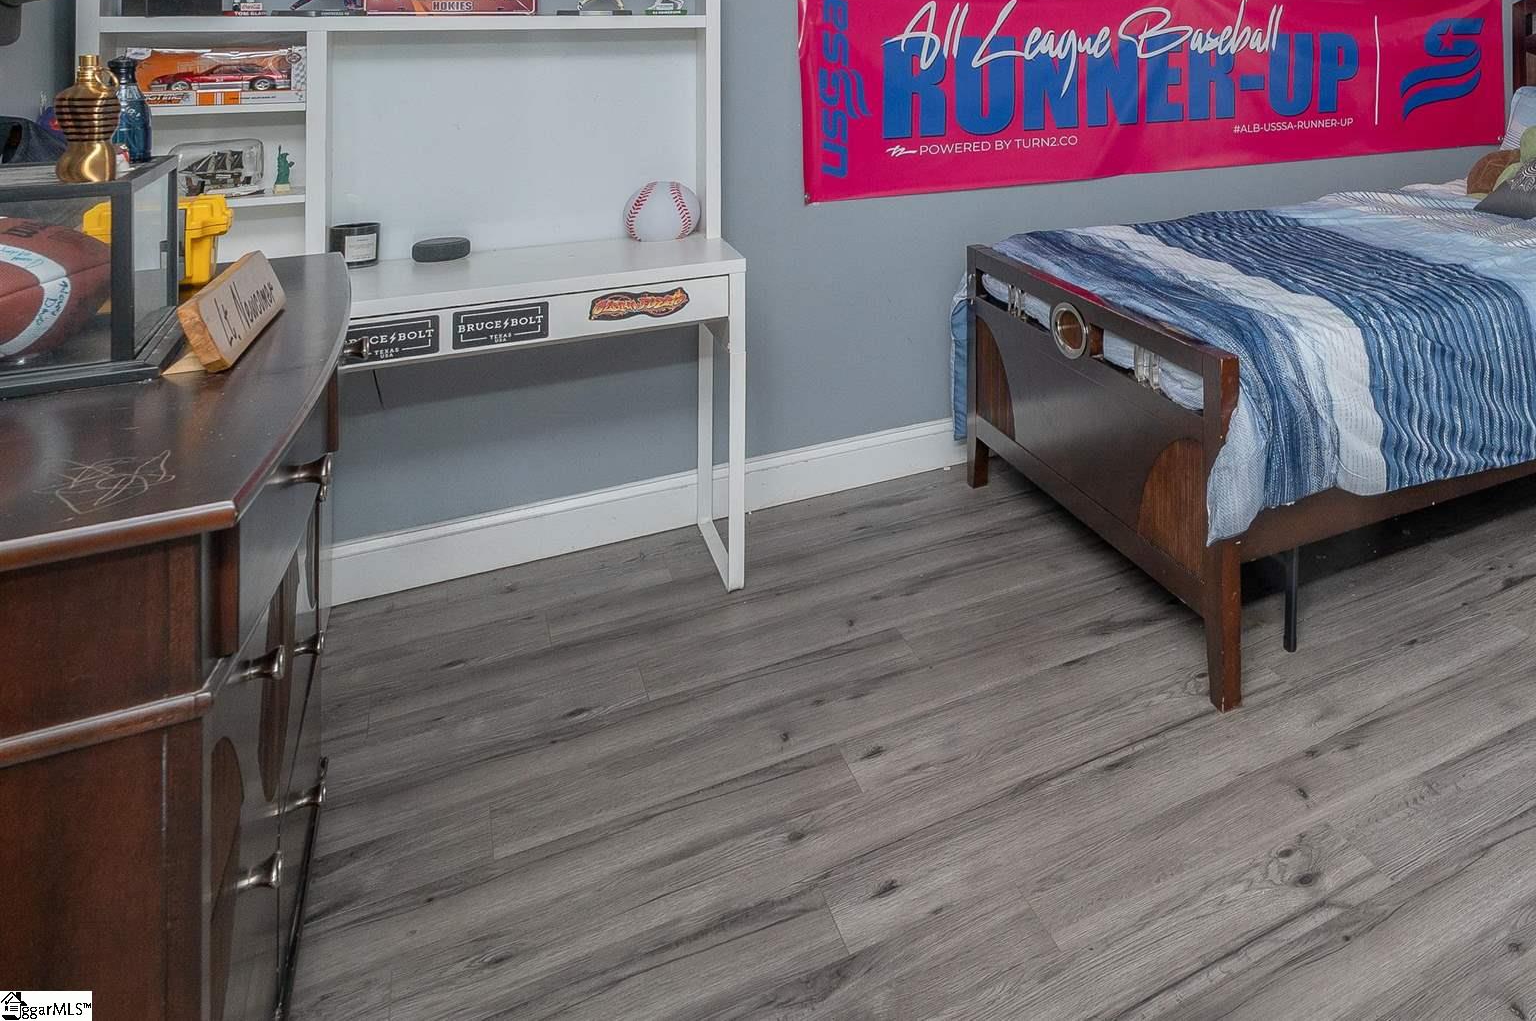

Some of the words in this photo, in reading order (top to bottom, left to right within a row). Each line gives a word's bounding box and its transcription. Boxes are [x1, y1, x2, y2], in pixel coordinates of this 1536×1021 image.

[432, 1, 474, 11] HOKIES
[881, 0, 970, 70] All
[882, 32, 1360, 140] RUNNER-UP
[1233, 117, 1354, 135] #ALB-USSSA-RUNNER-UP
[919, 141, 991, 155] POWERED
[994, 139, 1012, 151] BY
[1014, 134, 1079, 148] TURN2.CO
[458, 320, 502, 334] BRUCE
[510, 315, 544, 327] BOLT
[397, 329, 435, 341] BOLT
[489, 332, 512, 340] TEXAS
[374, 347, 400, 356] TEXAS
